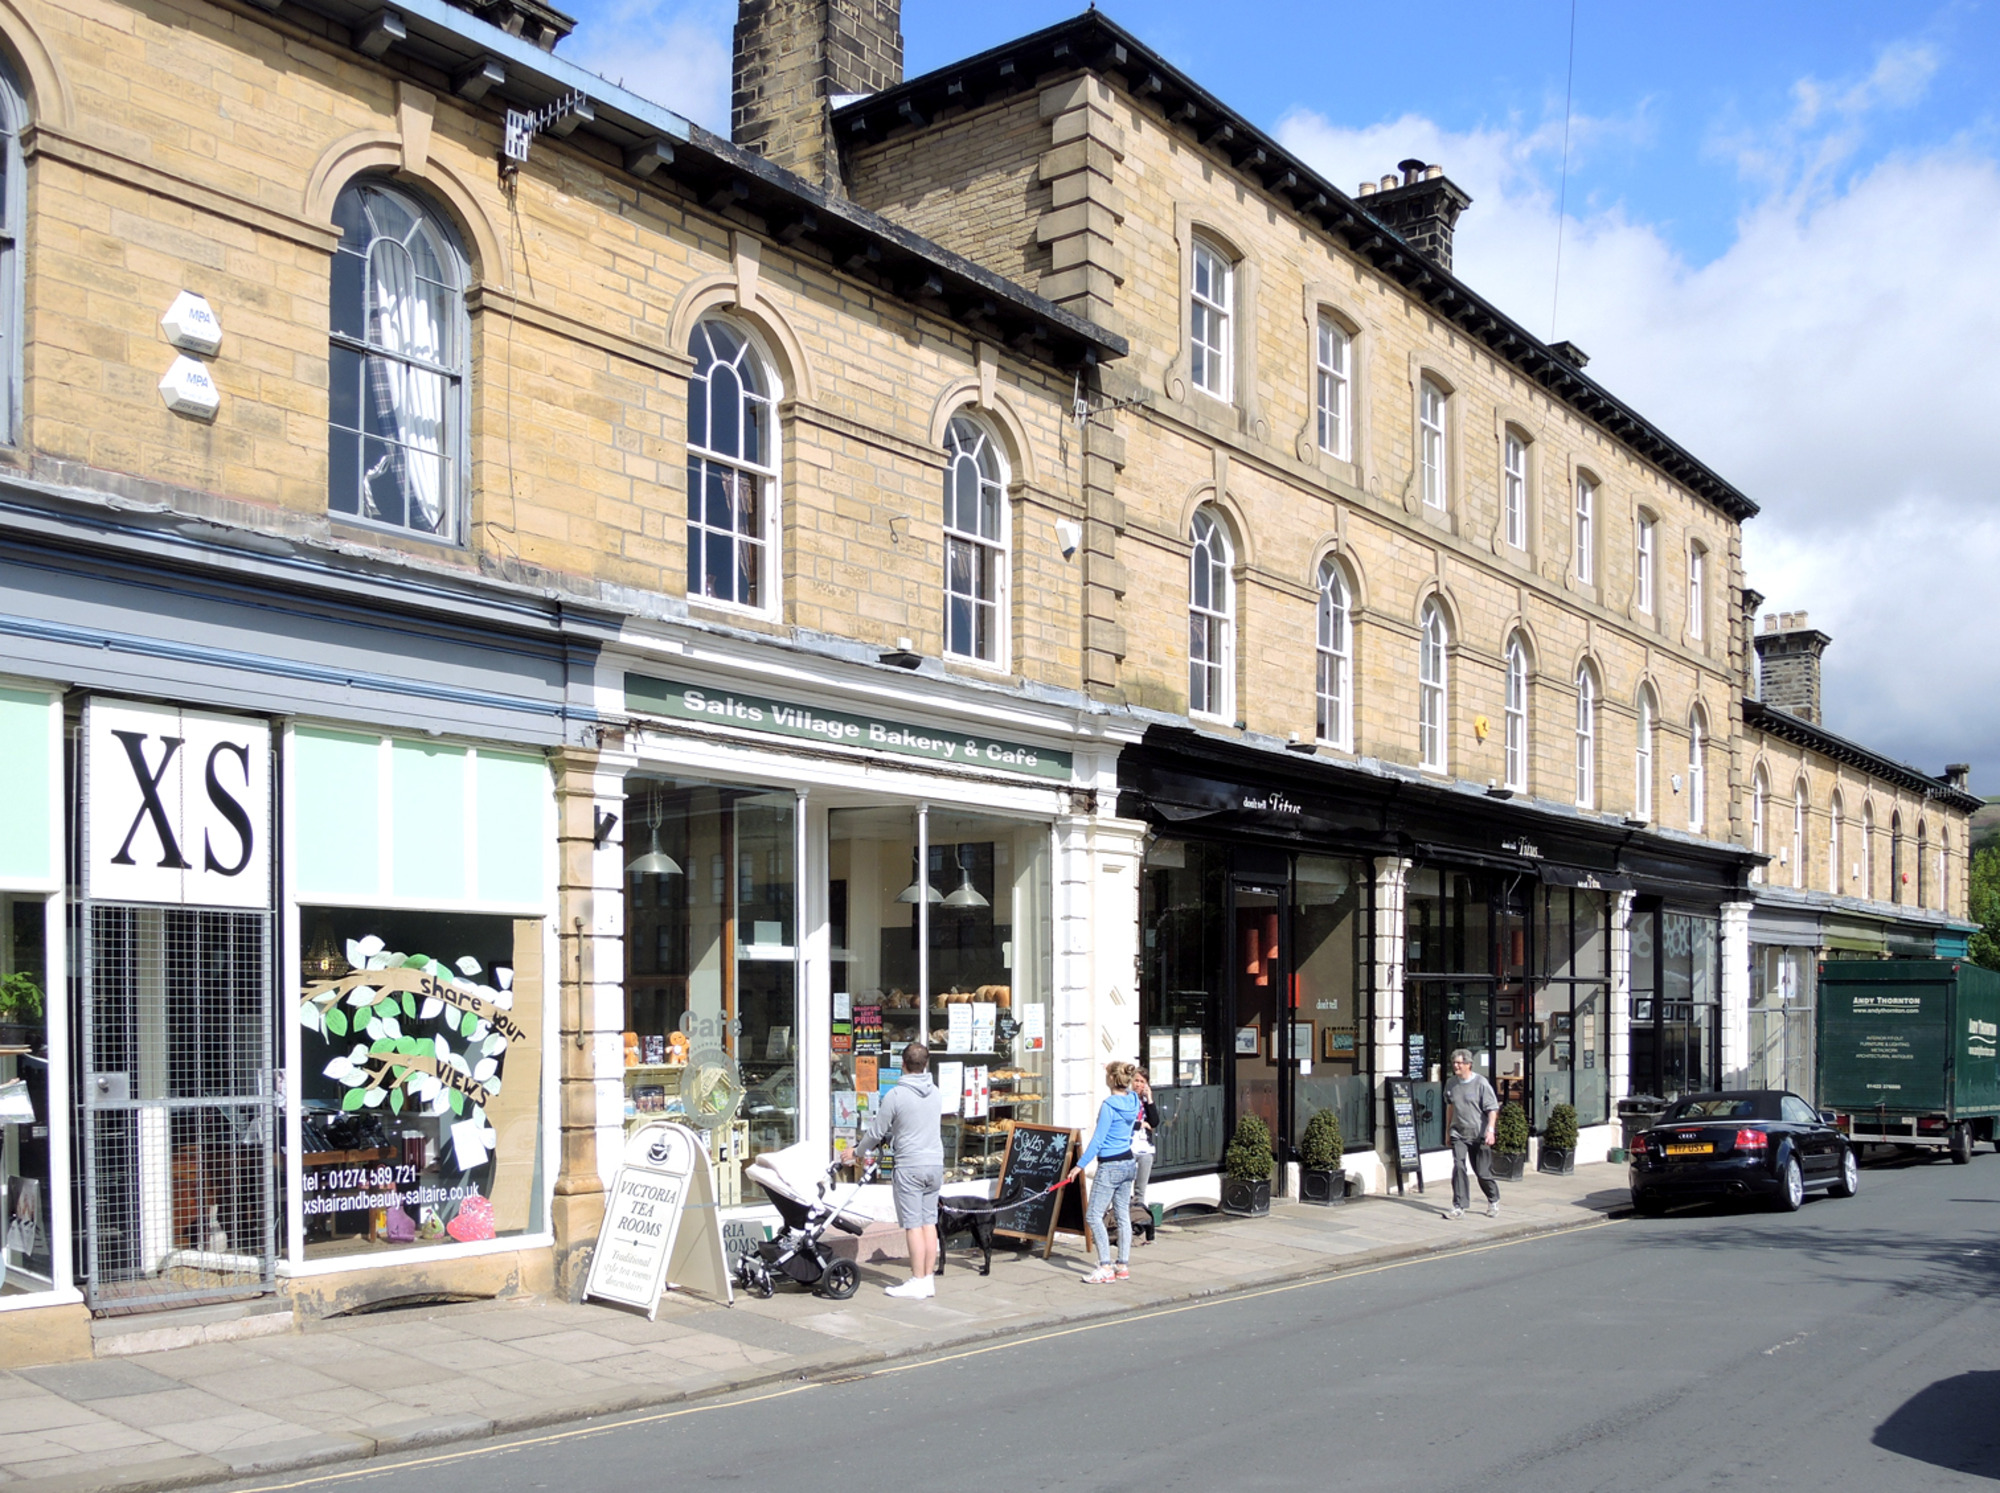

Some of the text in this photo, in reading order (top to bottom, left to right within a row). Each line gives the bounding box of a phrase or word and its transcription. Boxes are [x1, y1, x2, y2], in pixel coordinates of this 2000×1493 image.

[189, 308, 211, 324] MPA
[186, 372, 209, 388] MPA
[683, 690, 1038, 768] Salts Village Bakery & Café
[111, 729, 254, 877] XS
[420, 976, 482, 1011] share
[1876, 996, 1921, 1005] THORNTON
[485, 1010, 526, 1043] your
[678, 1009, 742, 1038] Café
[854, 1016, 882, 1024] PRIDE
[437, 1060, 490, 1108] VIEWS
[1013, 1131, 1045, 1152] Salts
[329, 1169, 366, 1189] 01274
[370, 1166, 393, 1186] 589
[395, 1165, 416, 1184] 721
[304, 1182, 480, 1214] xshairandbeauty-saltaire.co.uk
[620, 1180, 678, 1205] VICTORIA
[630, 1200, 655, 1219] TEA
[617, 1216, 662, 1238] ROOMS
[611, 1249, 652, 1268] Traditional
